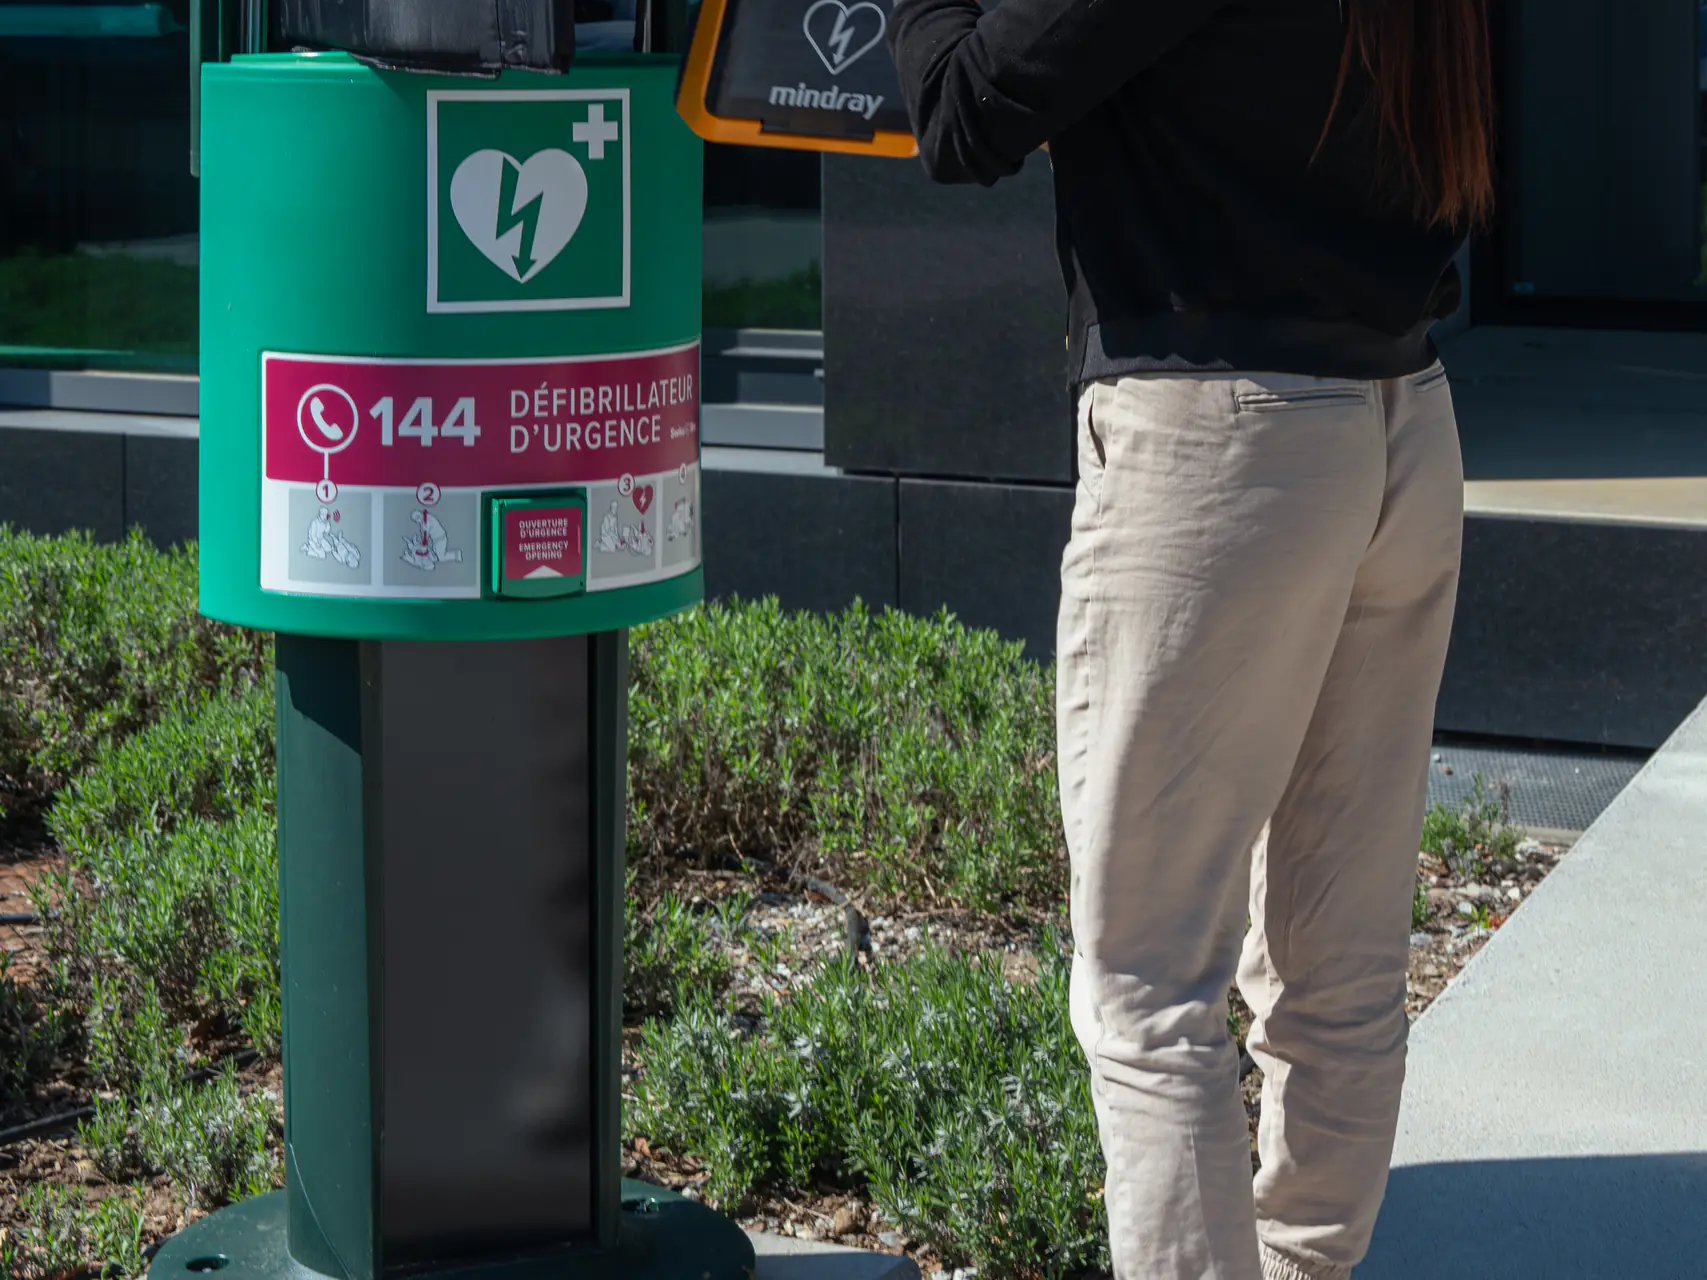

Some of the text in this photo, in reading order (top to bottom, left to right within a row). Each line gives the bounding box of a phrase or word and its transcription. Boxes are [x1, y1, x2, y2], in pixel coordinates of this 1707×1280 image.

[769, 82, 884, 120] mindray
[510, 374, 693, 418] DÉFIBRILLATEUR
[369, 396, 481, 447] 144
[510, 415, 661, 454] D’URGENCE
[322, 484, 329, 499] 1
[623, 478, 632, 492] 3
[423, 487, 434, 502] 2
[519, 518, 568, 529] OUVERTURE
[520, 527, 567, 538] D'URGENCE
[519, 540, 568, 552] EMERGENCY
[525, 550, 562, 561] OPENING
